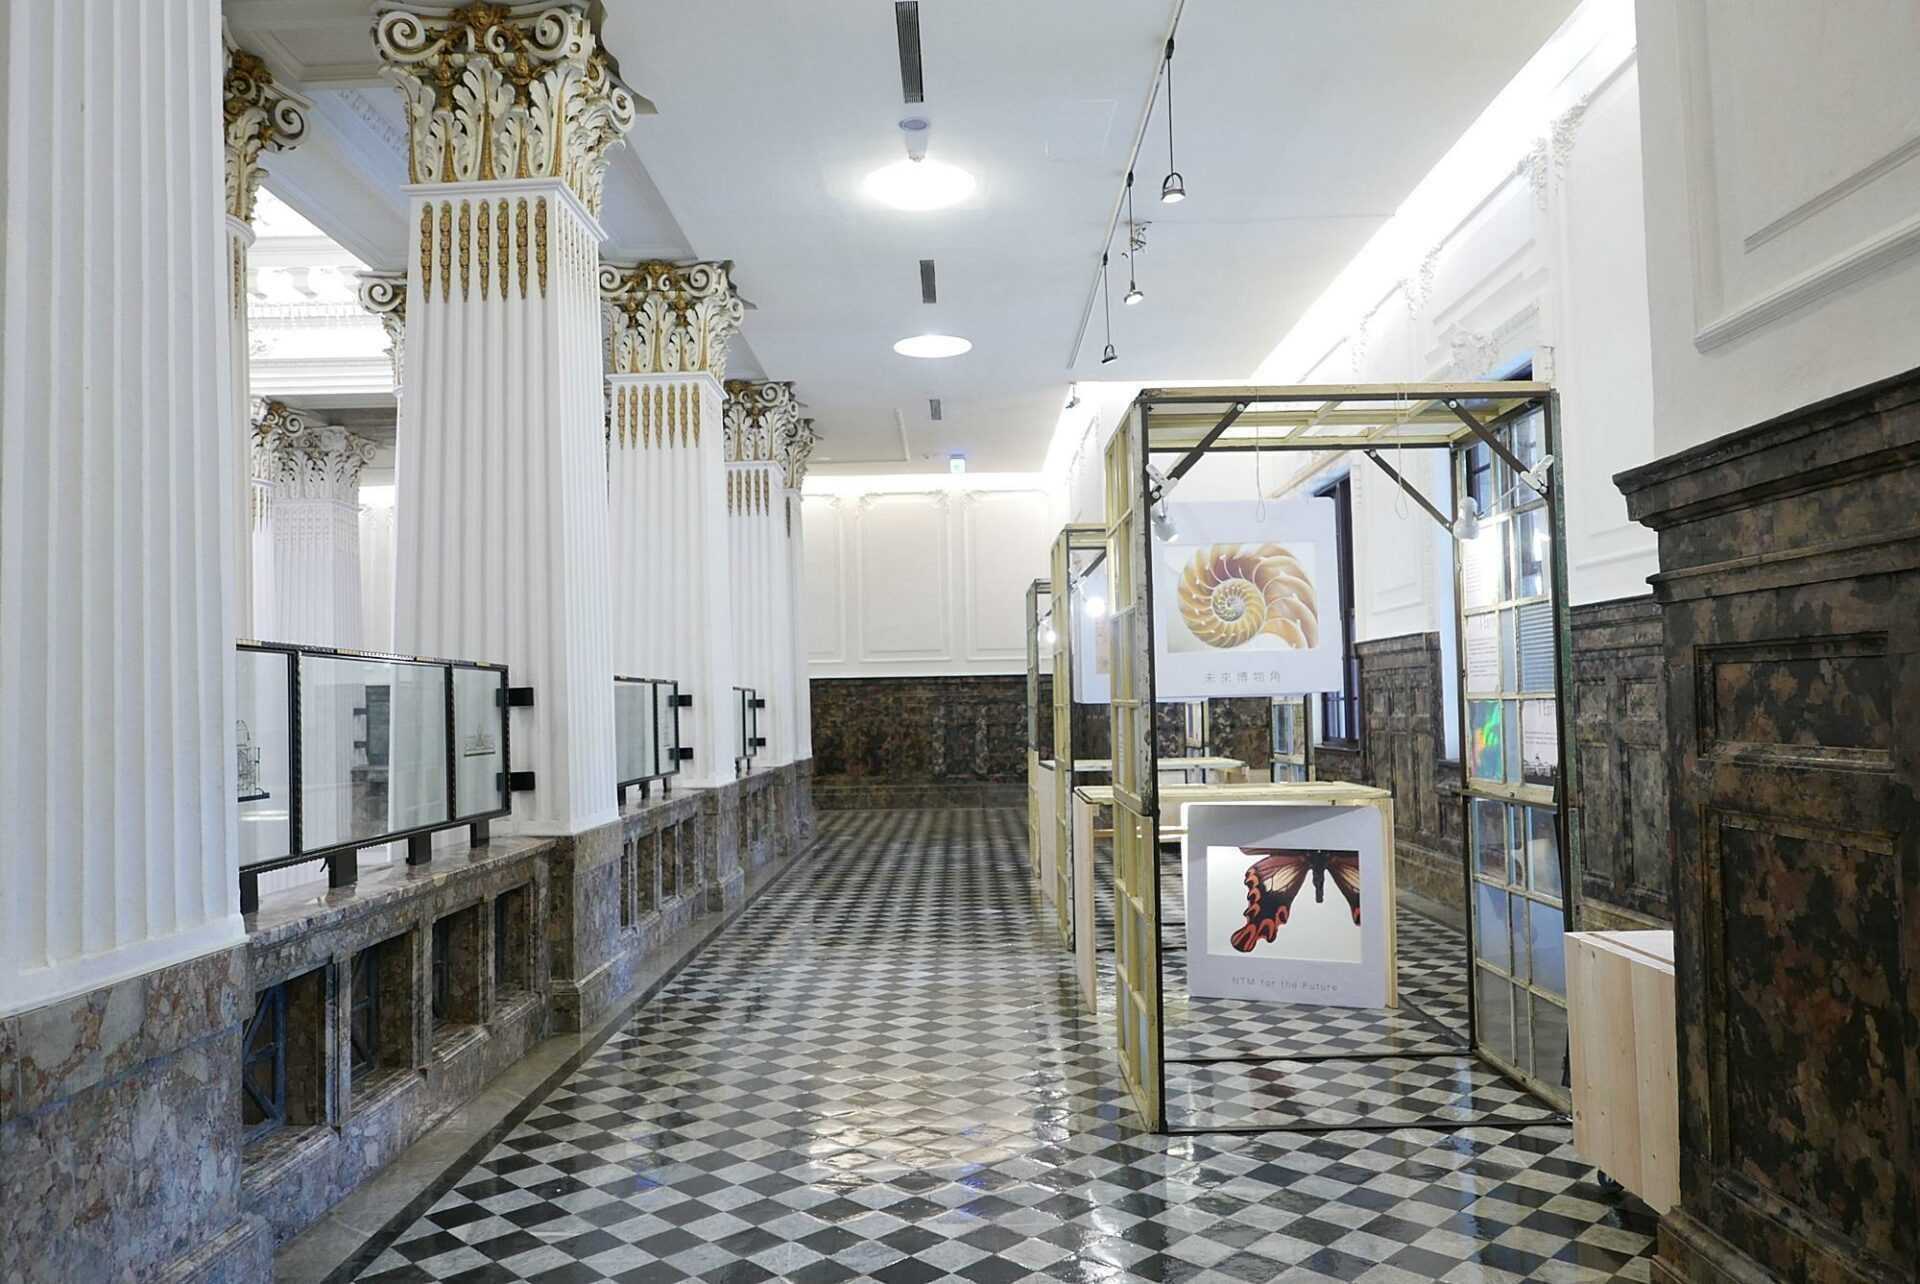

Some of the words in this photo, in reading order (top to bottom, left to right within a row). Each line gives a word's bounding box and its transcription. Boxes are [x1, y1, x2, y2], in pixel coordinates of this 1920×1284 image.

[1232, 976, 1256, 985] NTM
[1260, 978, 1276, 987] for
[1281, 978, 1298, 990] the
[1302, 981, 1339, 992] Future
